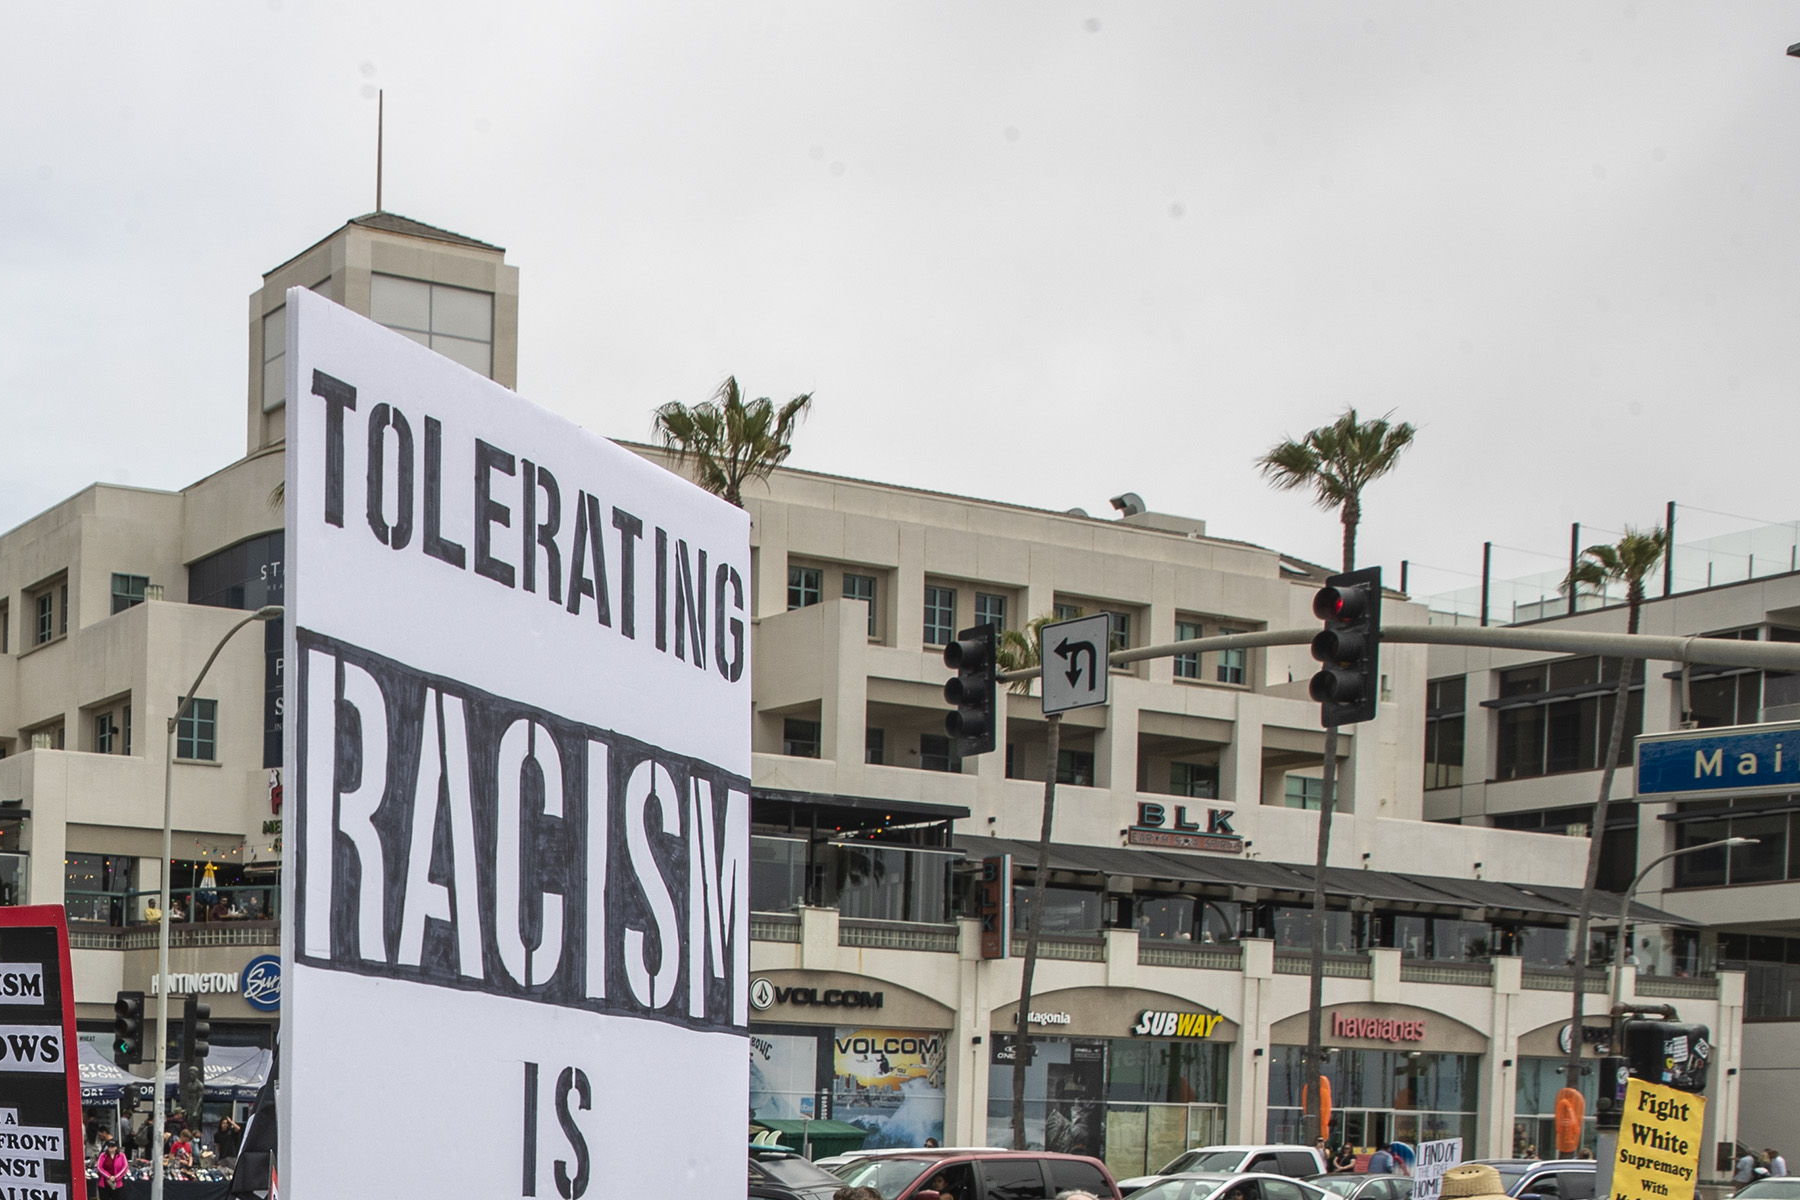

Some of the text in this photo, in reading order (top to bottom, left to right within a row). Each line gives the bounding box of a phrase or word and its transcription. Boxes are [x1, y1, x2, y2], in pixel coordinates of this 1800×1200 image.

[311, 367, 744, 684] TOLERATING
[1694, 743, 1800, 779] Mai
[1137, 802, 1235, 833] BLK
[304, 648, 750, 1028] RACISM
[1174, 836, 1198, 847] SA
[982, 863, 997, 933] BLK
[151, 967, 281, 999] HNTINGTON Sur
[775, 986, 883, 1008] VOLCOM
[1016, 1010, 1071, 1026] tagonia
[1135, 1010, 1223, 1037] SUBWAY
[1331, 1011, 1426, 1042] havaianas
[835, 1038, 939, 1054] VOLCOM
[83, 1088, 104, 1097] ORT
[1637, 1090, 1690, 1122] Fight
[5, 1112, 17, 1125] A
[1416, 1142, 1444, 1167] LAND
[1632, 1123, 1689, 1155] White
[1619, 1149, 1693, 1181] Supremacy
[1641, 1179, 1669, 1196] With
